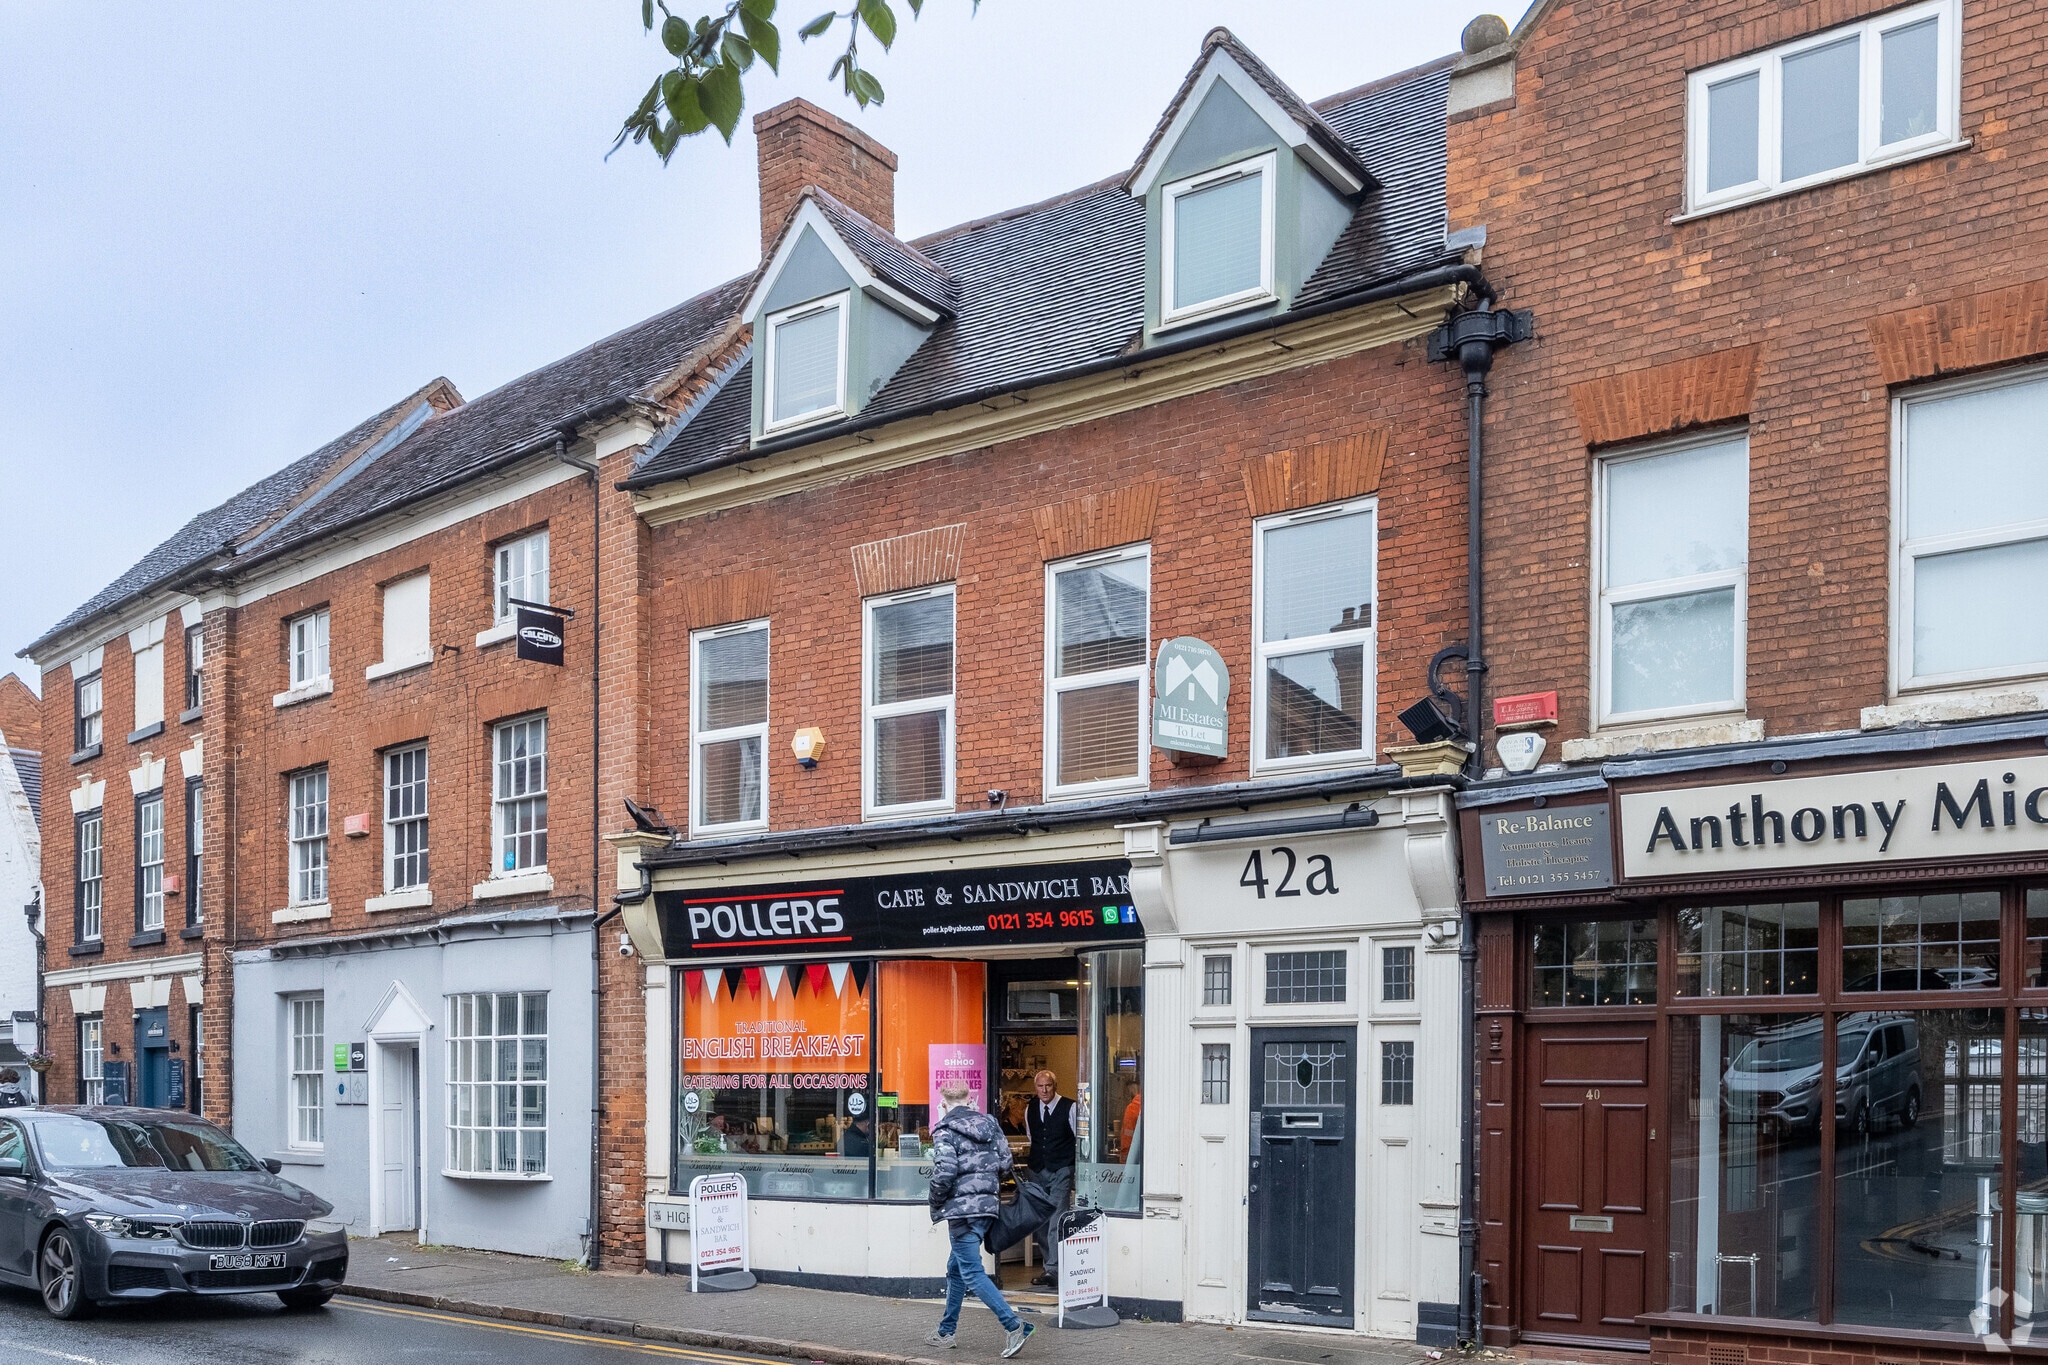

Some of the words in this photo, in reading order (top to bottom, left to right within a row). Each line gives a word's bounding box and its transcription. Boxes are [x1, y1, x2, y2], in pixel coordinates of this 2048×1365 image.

[1160, 703, 1177, 720] MI
[1180, 707, 1223, 728] Estates
[1175, 724, 1188, 737] To
[1190, 726, 1206, 740] Let
[1645, 793, 1907, 853] Anthony
[1931, 771, 2048, 832] Mic
[1496, 814, 1593, 835] Re-Balance
[1500, 840, 1559, 852] Acupuncture,
[1561, 836, 1593, 847] Beauty
[1506, 859, 1541, 868] Holistic
[1544, 855, 1589, 866] Therapies
[1240, 846, 1340, 899] 42a
[1497, 876, 1516, 886] Tel:
[1519, 874, 1545, 885] 0121
[1550, 872, 1570, 883] 355
[1574, 870, 1600, 881] 5457
[877, 888, 925, 909] CAFE
[935, 886, 953, 906] &
[962, 878, 1080, 904] SANDWICH
[1090, 874, 1131, 897] BAR
[687, 898, 844, 940] POLLERS
[987, 912, 1021, 930] 0121
[1025, 911, 1054, 929] 354
[1059, 909, 1095, 927] 9615
[735, 1020, 807, 1034] TRADITIONAL
[683, 1036, 755, 1059] ENGLISH
[760, 1034, 865, 1058] BREAKFAST
[944, 1058, 975, 1066] SHMOO
[683, 1074, 740, 1090] CATERING
[742, 1074, 767, 1089] FOR
[769, 1074, 791, 1089] ALL
[793, 1073, 867, 1089] OCCASIONS
[1585, 1089, 1600, 1100] 40
[701, 1182, 738, 1194] POLLERS
[711, 1205, 729, 1215] CAFE
[700, 1223, 740, 1236] SANDWICH
[1068, 1223, 1098, 1235] POLLERS
[714, 1234, 728, 1243] BAR
[701, 1250, 714, 1258] 0121
[716, 1247, 727, 1256] 354
[728, 1245, 741, 1254] 9615
[1076, 1247, 1090, 1256] CAFE
[215, 1254, 253, 1269] BU68
[1069, 1268, 1096, 1277] SANDWICH
[1065, 1289, 1077, 1297] 0121
